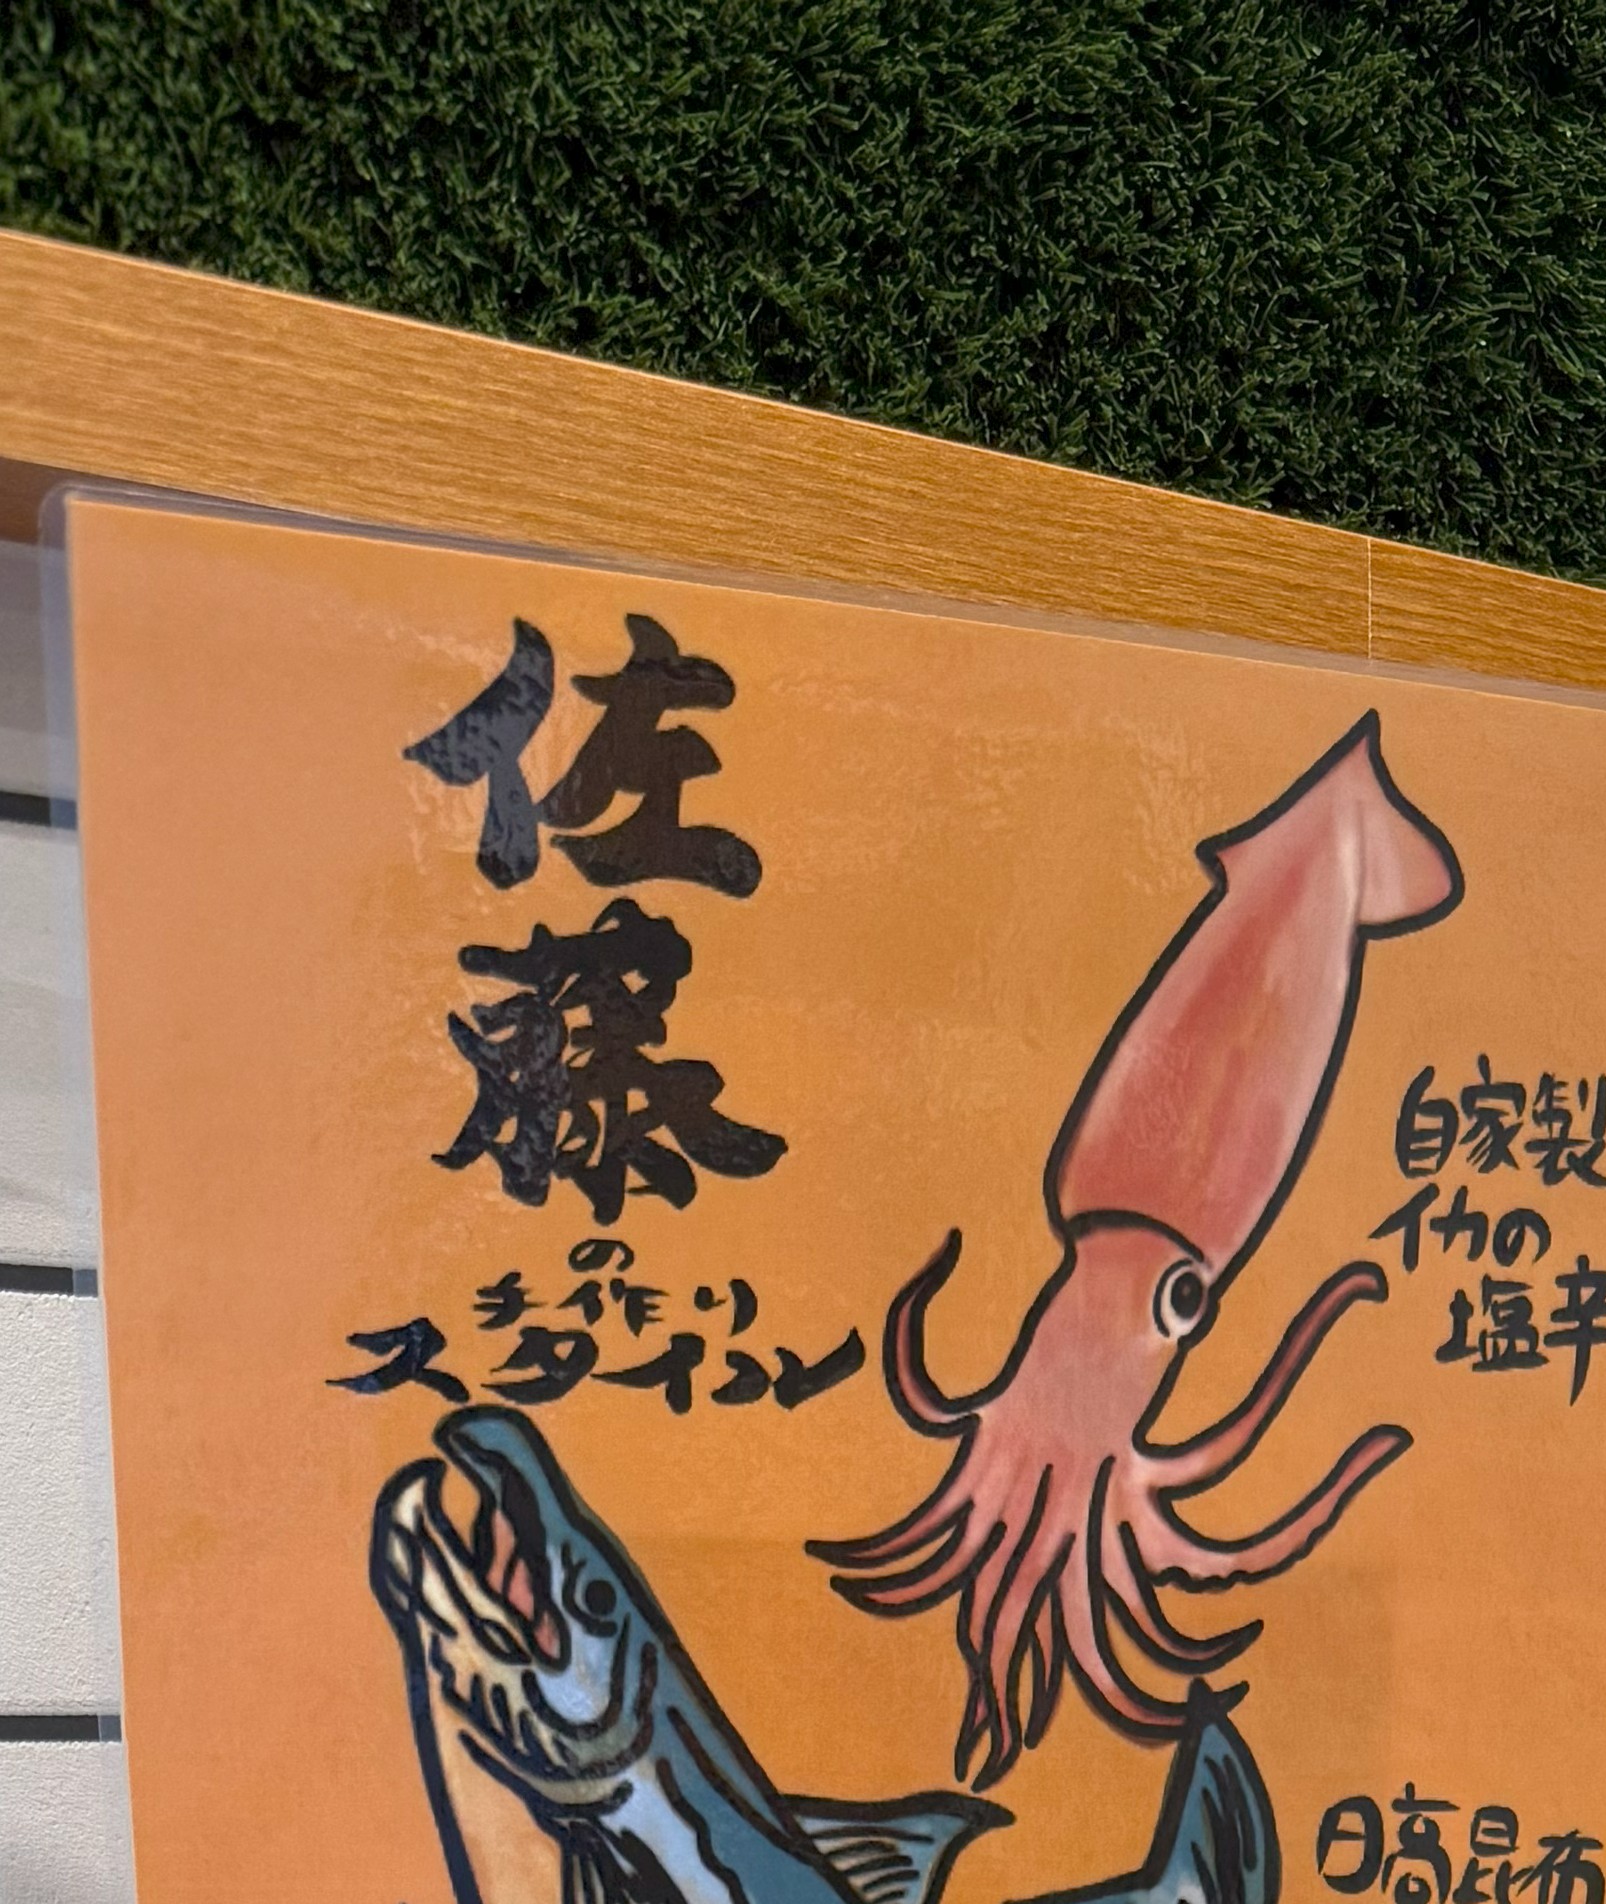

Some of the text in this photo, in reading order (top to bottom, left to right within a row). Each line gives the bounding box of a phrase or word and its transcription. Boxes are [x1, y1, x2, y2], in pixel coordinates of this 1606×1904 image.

[404, 613, 789, 1226] 佐藤
[568, 1239, 634, 1271] の
[1368, 1182, 1551, 1272] イカの
[472, 1271, 758, 1336] 手作り
[325, 1314, 866, 1414] スタイル
